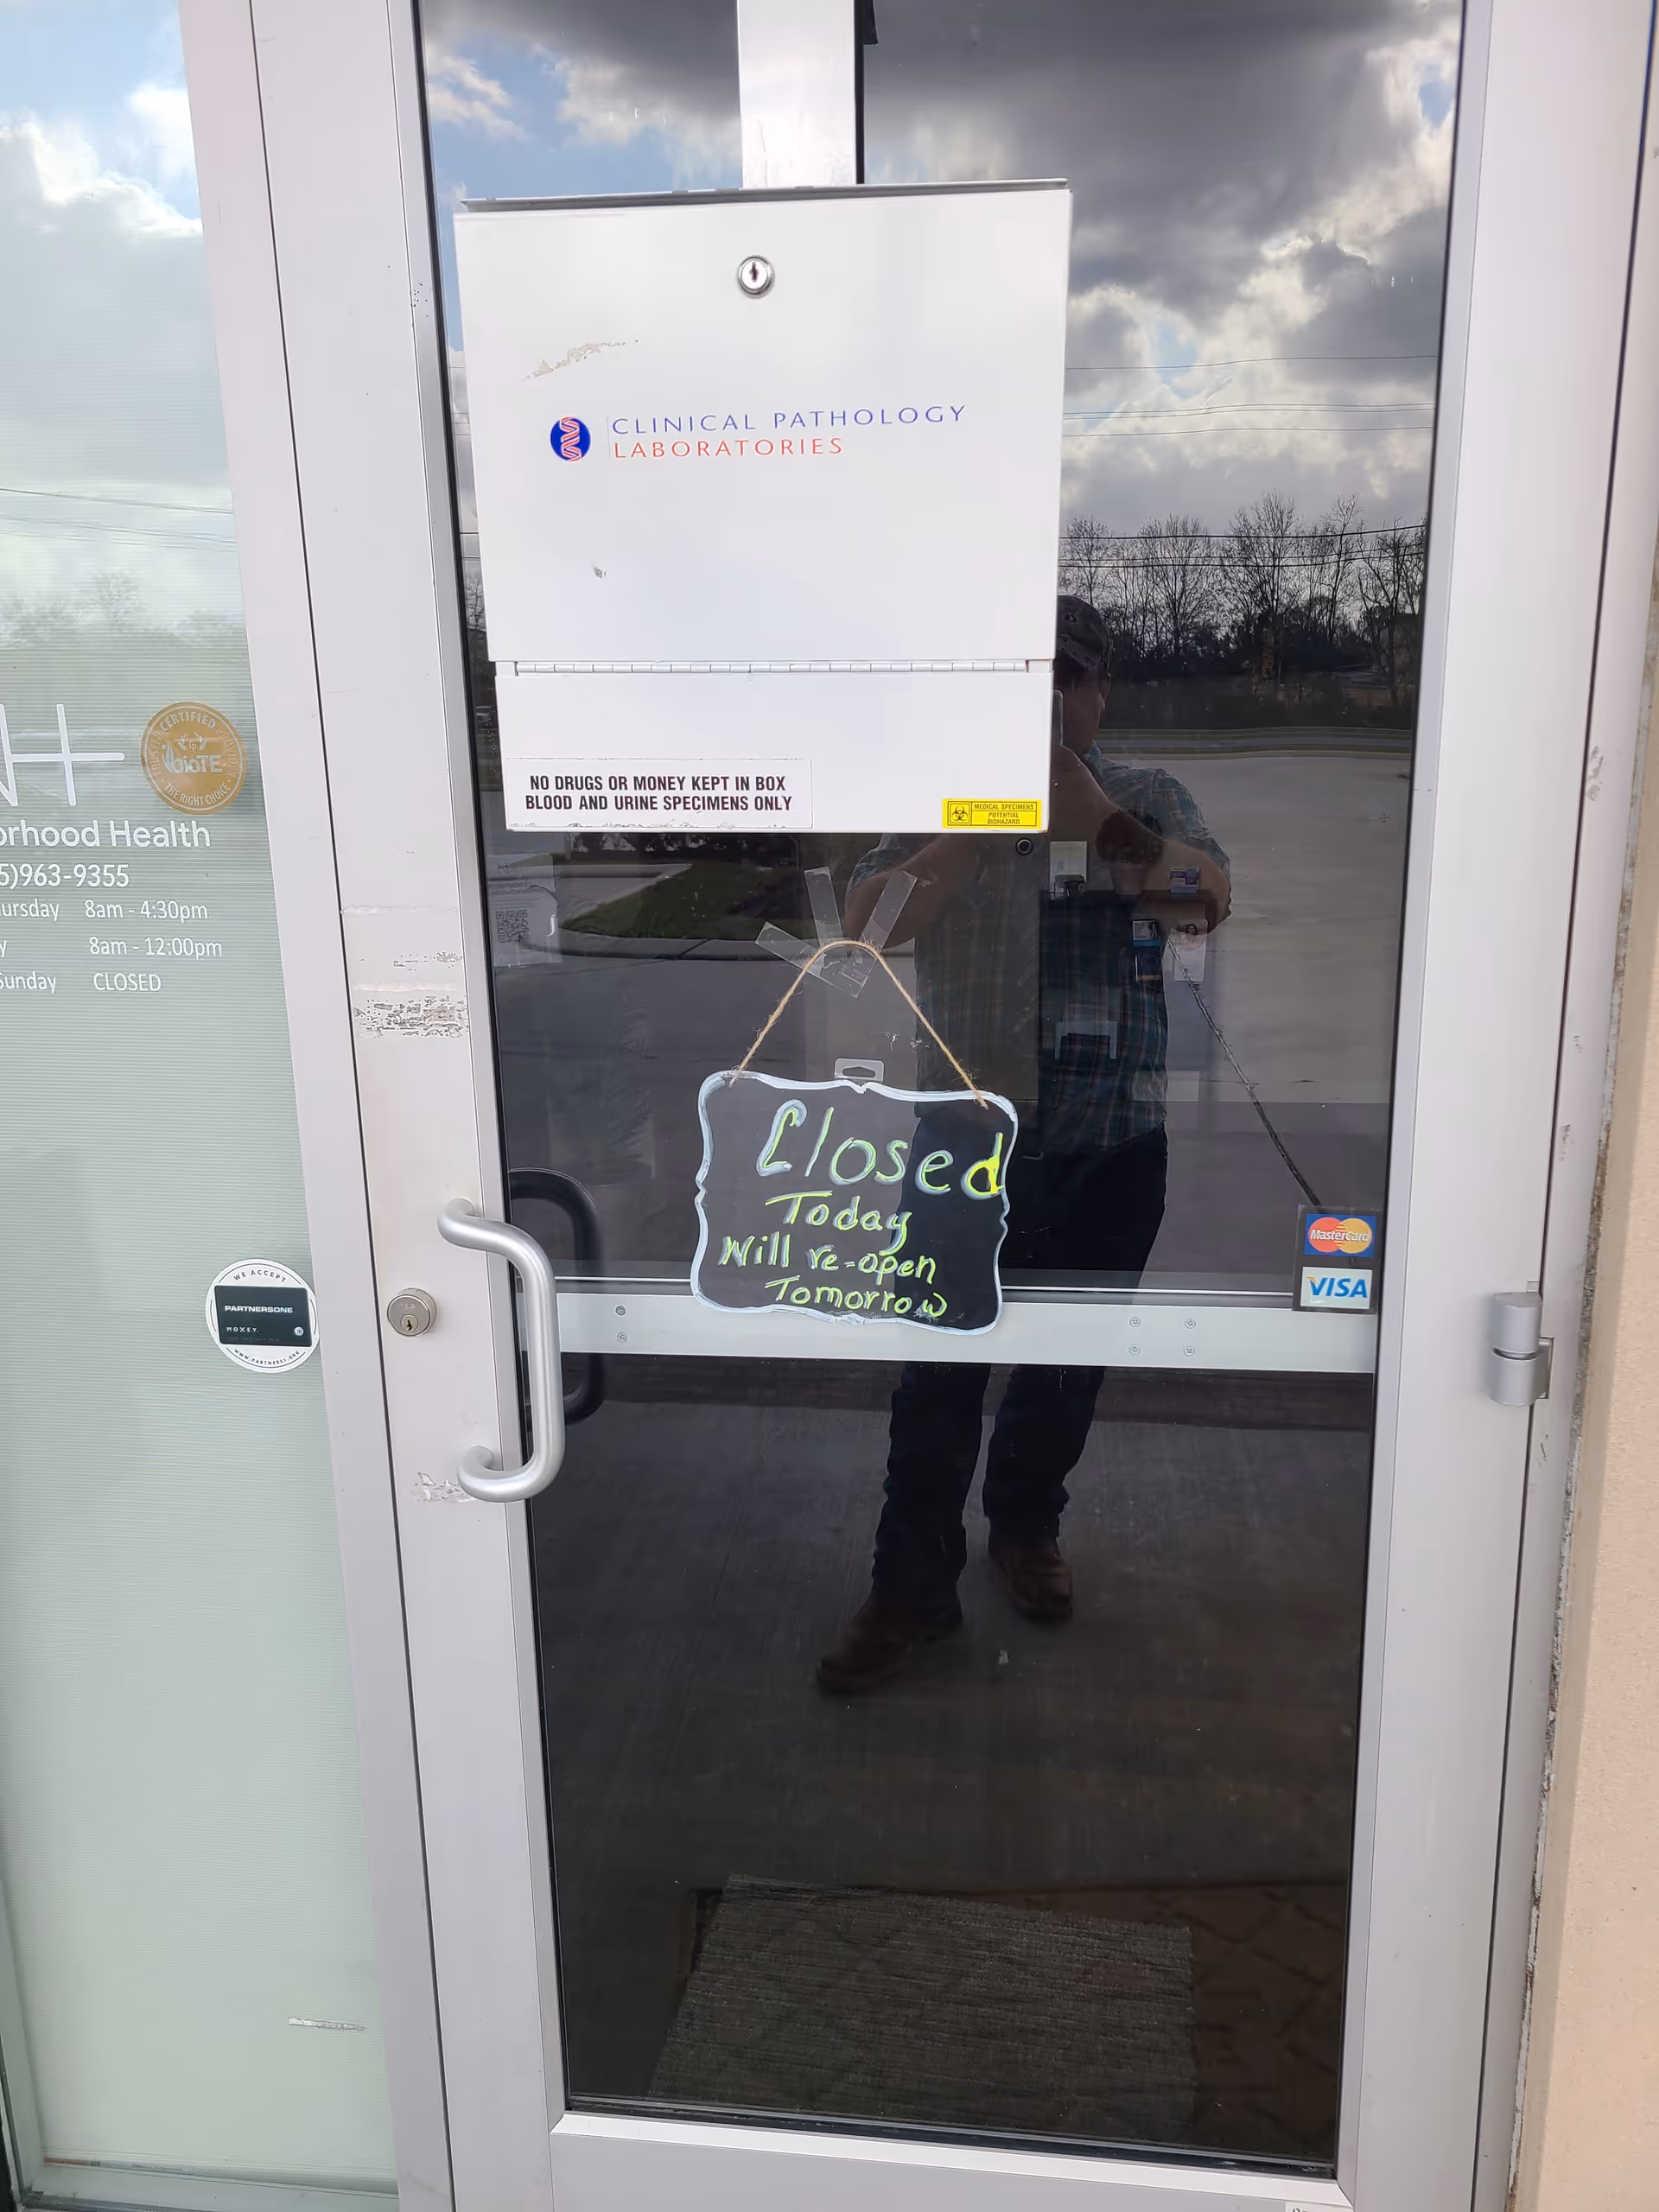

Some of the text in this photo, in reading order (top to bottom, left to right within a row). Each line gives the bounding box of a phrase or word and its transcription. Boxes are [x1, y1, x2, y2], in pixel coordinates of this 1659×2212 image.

[612, 404, 966, 435] CLINICAL PATHOLOGY
[614, 437, 844, 459] LABORATORIES
[160, 711, 216, 732] CERTIFIED
[164, 782, 231, 806] THE RIGHT CHOICE
[530, 775, 786, 791] NO DRUGS OR MONEY KEPT IN BOX
[525, 795, 792, 811] BLOOD AND URINE SPECIMENS ONLY
[110, 820, 212, 847] Health
[85, 900, 124, 919] 8am
[140, 900, 208, 923] 4:30pm
[89, 937, 128, 955] 8am
[144, 938, 223, 960] 12:00pm
[93, 973, 162, 992] CLOSED
[757, 1099, 1005, 1199] Closed
[765, 1190, 912, 1255] Today
[1309, 1229, 1370, 1242] MasterCard
[718, 1231, 937, 1285] Will re-open
[233, 1269, 286, 1283] WE ACCEPT
[1306, 1276, 1368, 1298] VISA
[765, 1274, 948, 1318] Tomorrow
[225, 1305, 294, 1313] PARTNERSONE
